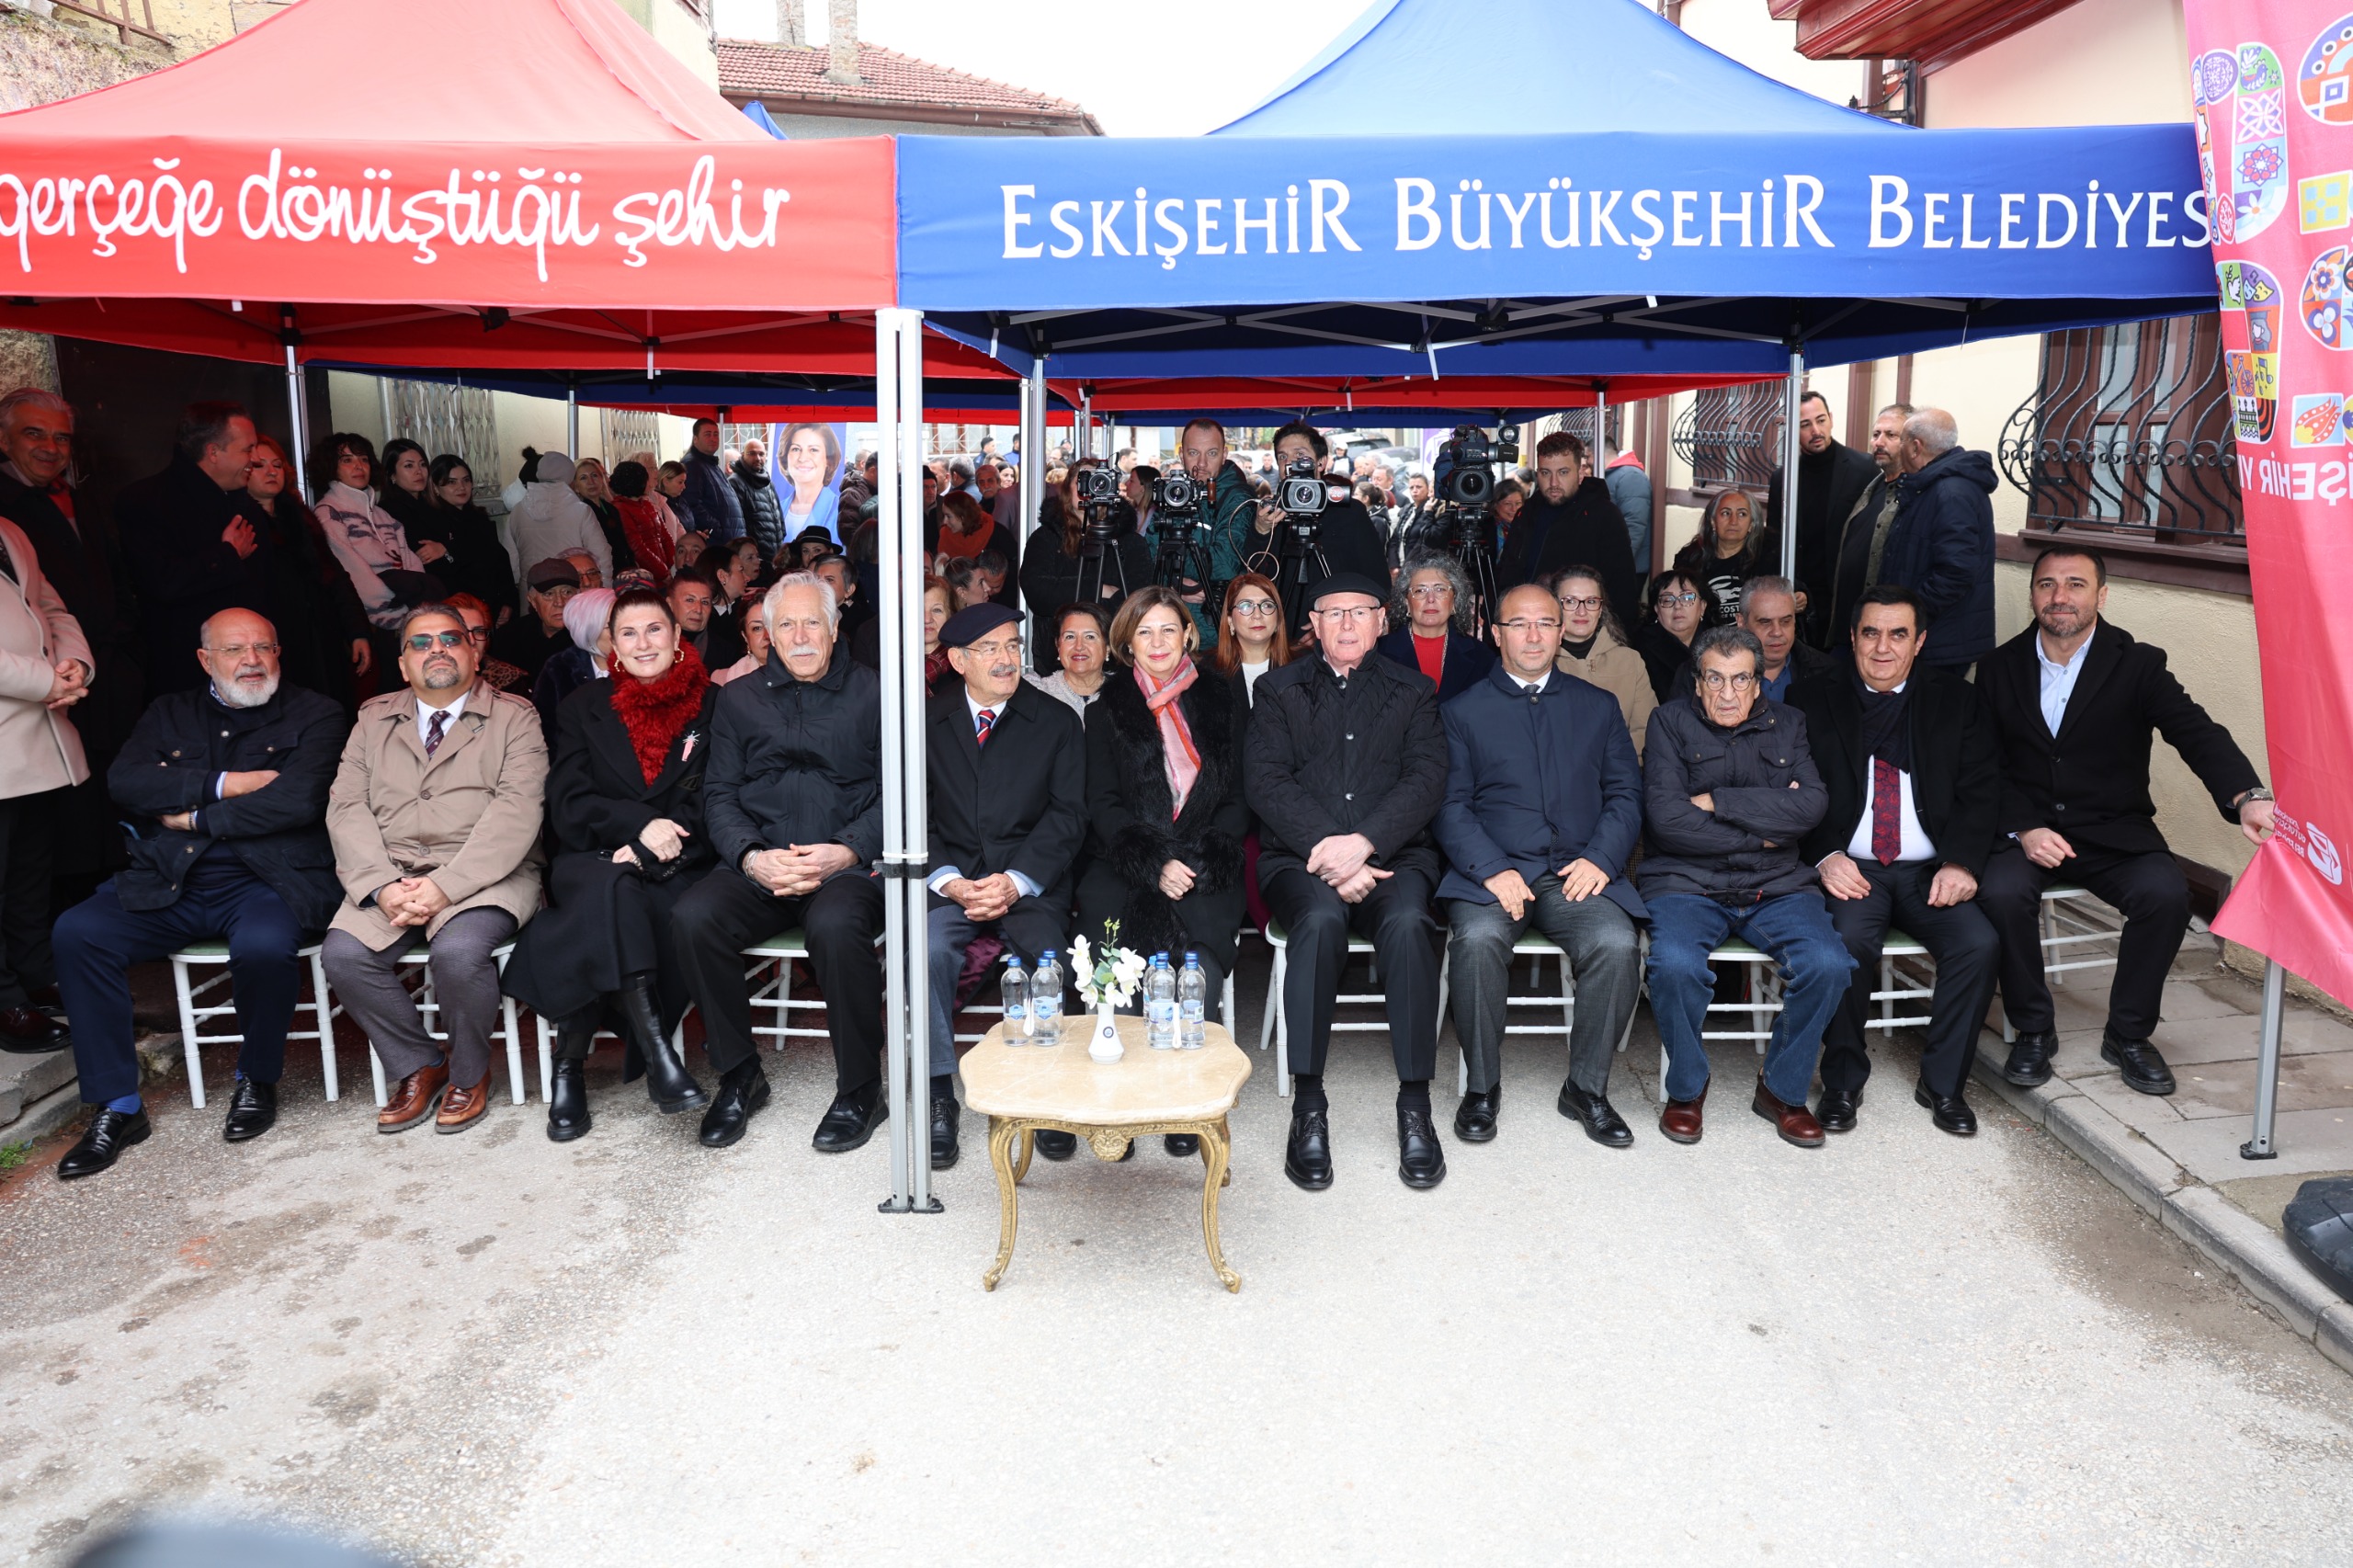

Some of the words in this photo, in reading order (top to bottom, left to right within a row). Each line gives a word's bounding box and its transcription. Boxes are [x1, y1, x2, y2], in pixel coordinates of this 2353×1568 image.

[0, 157, 222, 273] gerçeğe
[239, 148, 598, 282] dönüştüğü
[613, 154, 790, 267] şehir
[1001, 179, 1362, 270] ESKİŞEHİR
[1394, 176, 1836, 260] BÜYÜKŞEHİR
